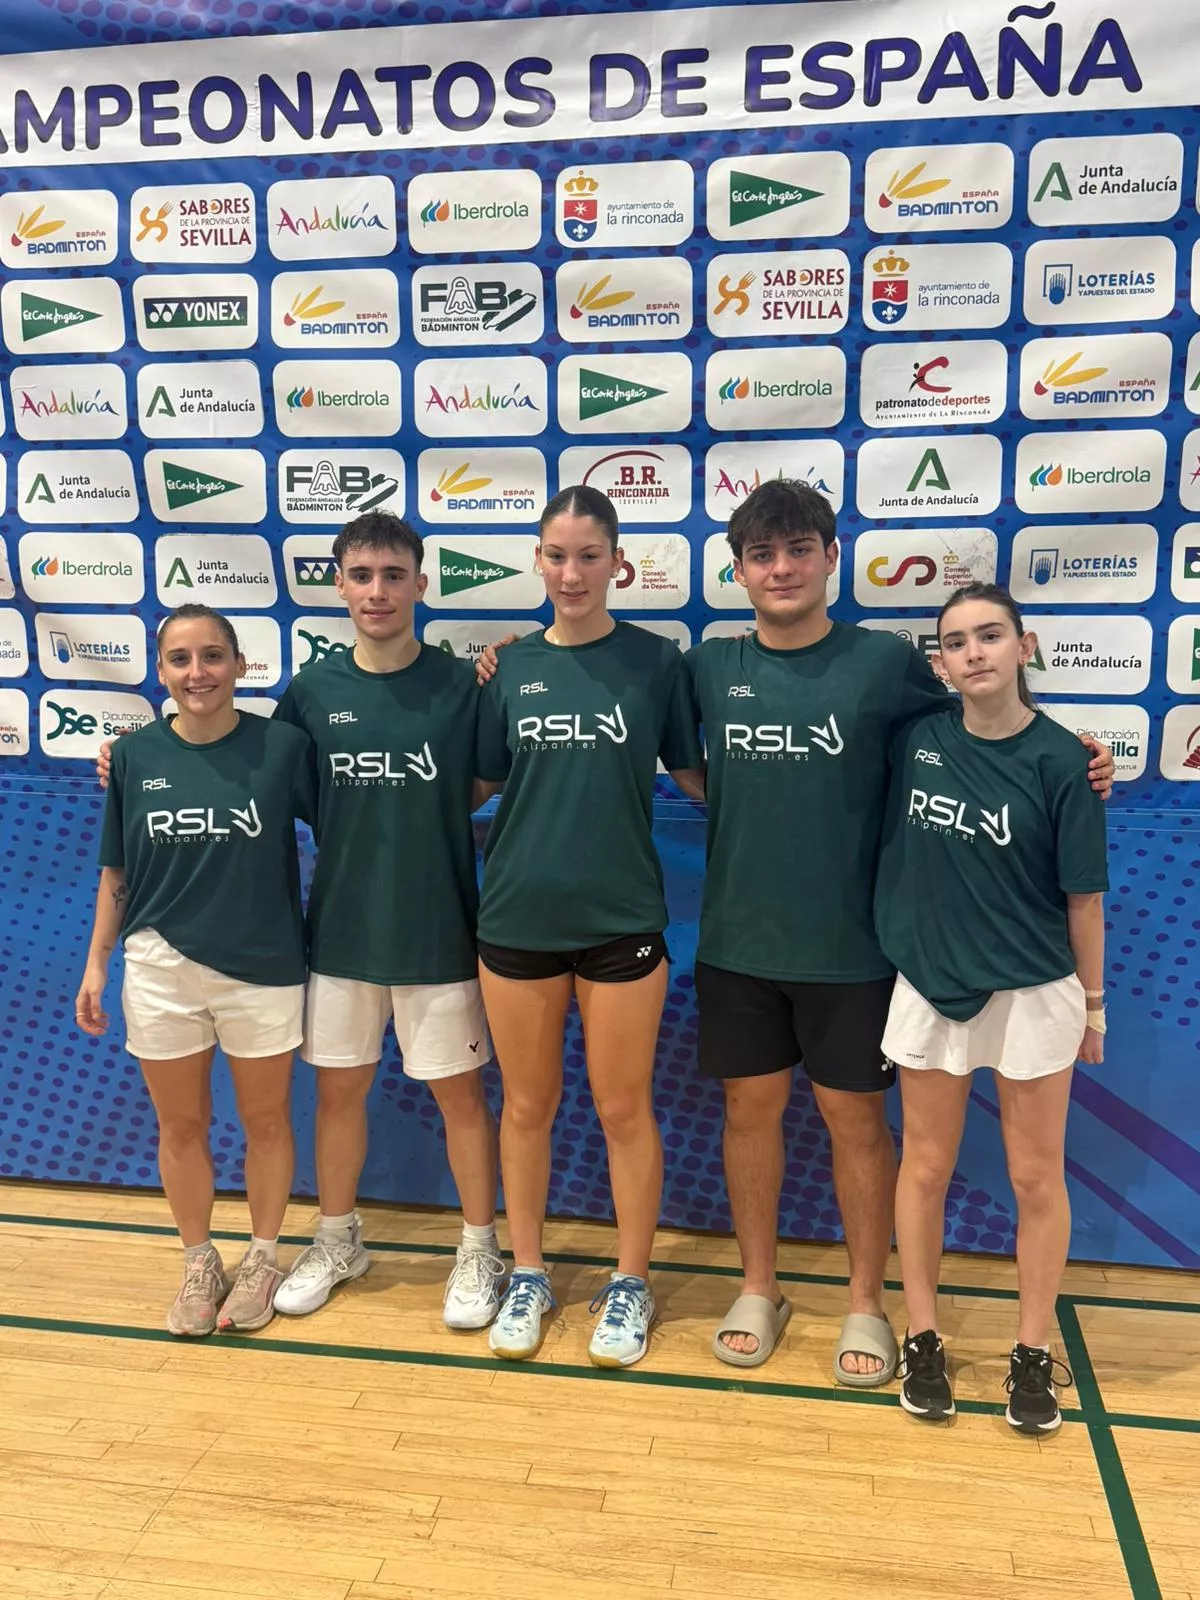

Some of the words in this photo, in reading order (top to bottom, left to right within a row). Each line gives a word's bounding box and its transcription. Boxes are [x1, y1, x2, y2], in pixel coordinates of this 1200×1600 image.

[589, 48, 709, 122] DE
[744, 1, 1143, 111] ESPAÑA
[1079, 164, 1124, 179] Junta
[1078, 180, 1097, 195] de
[1100, 176, 1177, 194] Andalucía
[732, 190, 742, 202] El
[743, 190, 766, 202] Corte
[180, 198, 250, 215] SABORES
[453, 201, 529, 221] Iberdrola
[607, 201, 661, 211] ayuntamiento
[663, 199, 674, 209] de
[898, 200, 998, 217] BADMINTON
[201, 217, 240, 225] PROVINCIA
[241, 216, 251, 224] DE
[275, 202, 389, 236] Andalucía
[607, 213, 617, 225] la
[621, 210, 684, 225] rinconada
[180, 228, 252, 246] SEVILLA
[27, 239, 106, 255] BADMINTON
[763, 268, 845, 287] SABORES
[1078, 269, 1156, 287] LOTERÍAS
[763, 290, 773, 298] DE
[775, 290, 785, 298] LA
[787, 289, 831, 297] PROVINCIA
[833, 288, 844, 297] DE
[918, 282, 976, 292] ayuntamiento
[978, 281, 990, 290] de
[1129, 287, 1155, 295] ESTADO
[918, 293, 929, 307] la
[933, 291, 1000, 306] rinconada
[23, 309, 32, 321] El
[32, 310, 53, 321] Corte
[183, 301, 241, 322] YONEX
[762, 300, 844, 320] SEVILLA
[588, 313, 680, 327] BADMINTON
[301, 321, 388, 335] BADMINTON
[179, 387, 213, 399] Junta
[581, 388, 591, 399] El
[591, 388, 614, 399] Corte
[754, 379, 832, 398] Iberdrola
[20, 389, 120, 417] Andalucía
[317, 390, 390, 407] Iberdrola
[425, 383, 540, 413] Andalucía
[1053, 389, 1155, 405] BADMINTON
[180, 402, 194, 413] de
[197, 398, 256, 413] Andalucía
[58, 475, 90, 486] Junta
[1067, 465, 1151, 485] Iberdrola
[59, 488, 74, 500] de
[76, 486, 131, 499] Andalucía
[166, 481, 175, 490] El
[175, 481, 195, 491] Corte
[606, 487, 670, 498] RINCONADA
[448, 498, 535, 511] BADMINTON
[879, 497, 909, 507] Junta
[911, 495, 924, 506] de
[926, 493, 979, 506] Andalucía
[62, 561, 133, 577] Iberdrola
[196, 560, 229, 570] Junta
[1063, 554, 1138, 570] LOTERÍAS
[197, 572, 212, 584] de
[214, 572, 269, 584] Andalucía
[442, 565, 451, 576] El
[451, 565, 472, 576] Corte
[73, 641, 130, 655] LOTERÍAS
[1053, 641, 1093, 653] Junta
[1052, 656, 1069, 669] de
[1071, 654, 1142, 669] Andalucía
[520, 681, 549, 697] RSL
[728, 685, 756, 697] RSL
[102, 711, 151, 722] Diputación
[328, 710, 358, 725] RSL
[517, 713, 597, 742] RSL
[725, 723, 809, 753] RSL
[328, 751, 406, 778] RSL
[914, 748, 943, 767] RSL
[142, 777, 172, 792] RSL
[908, 788, 976, 836] RSL
[146, 807, 231, 838] RSL
